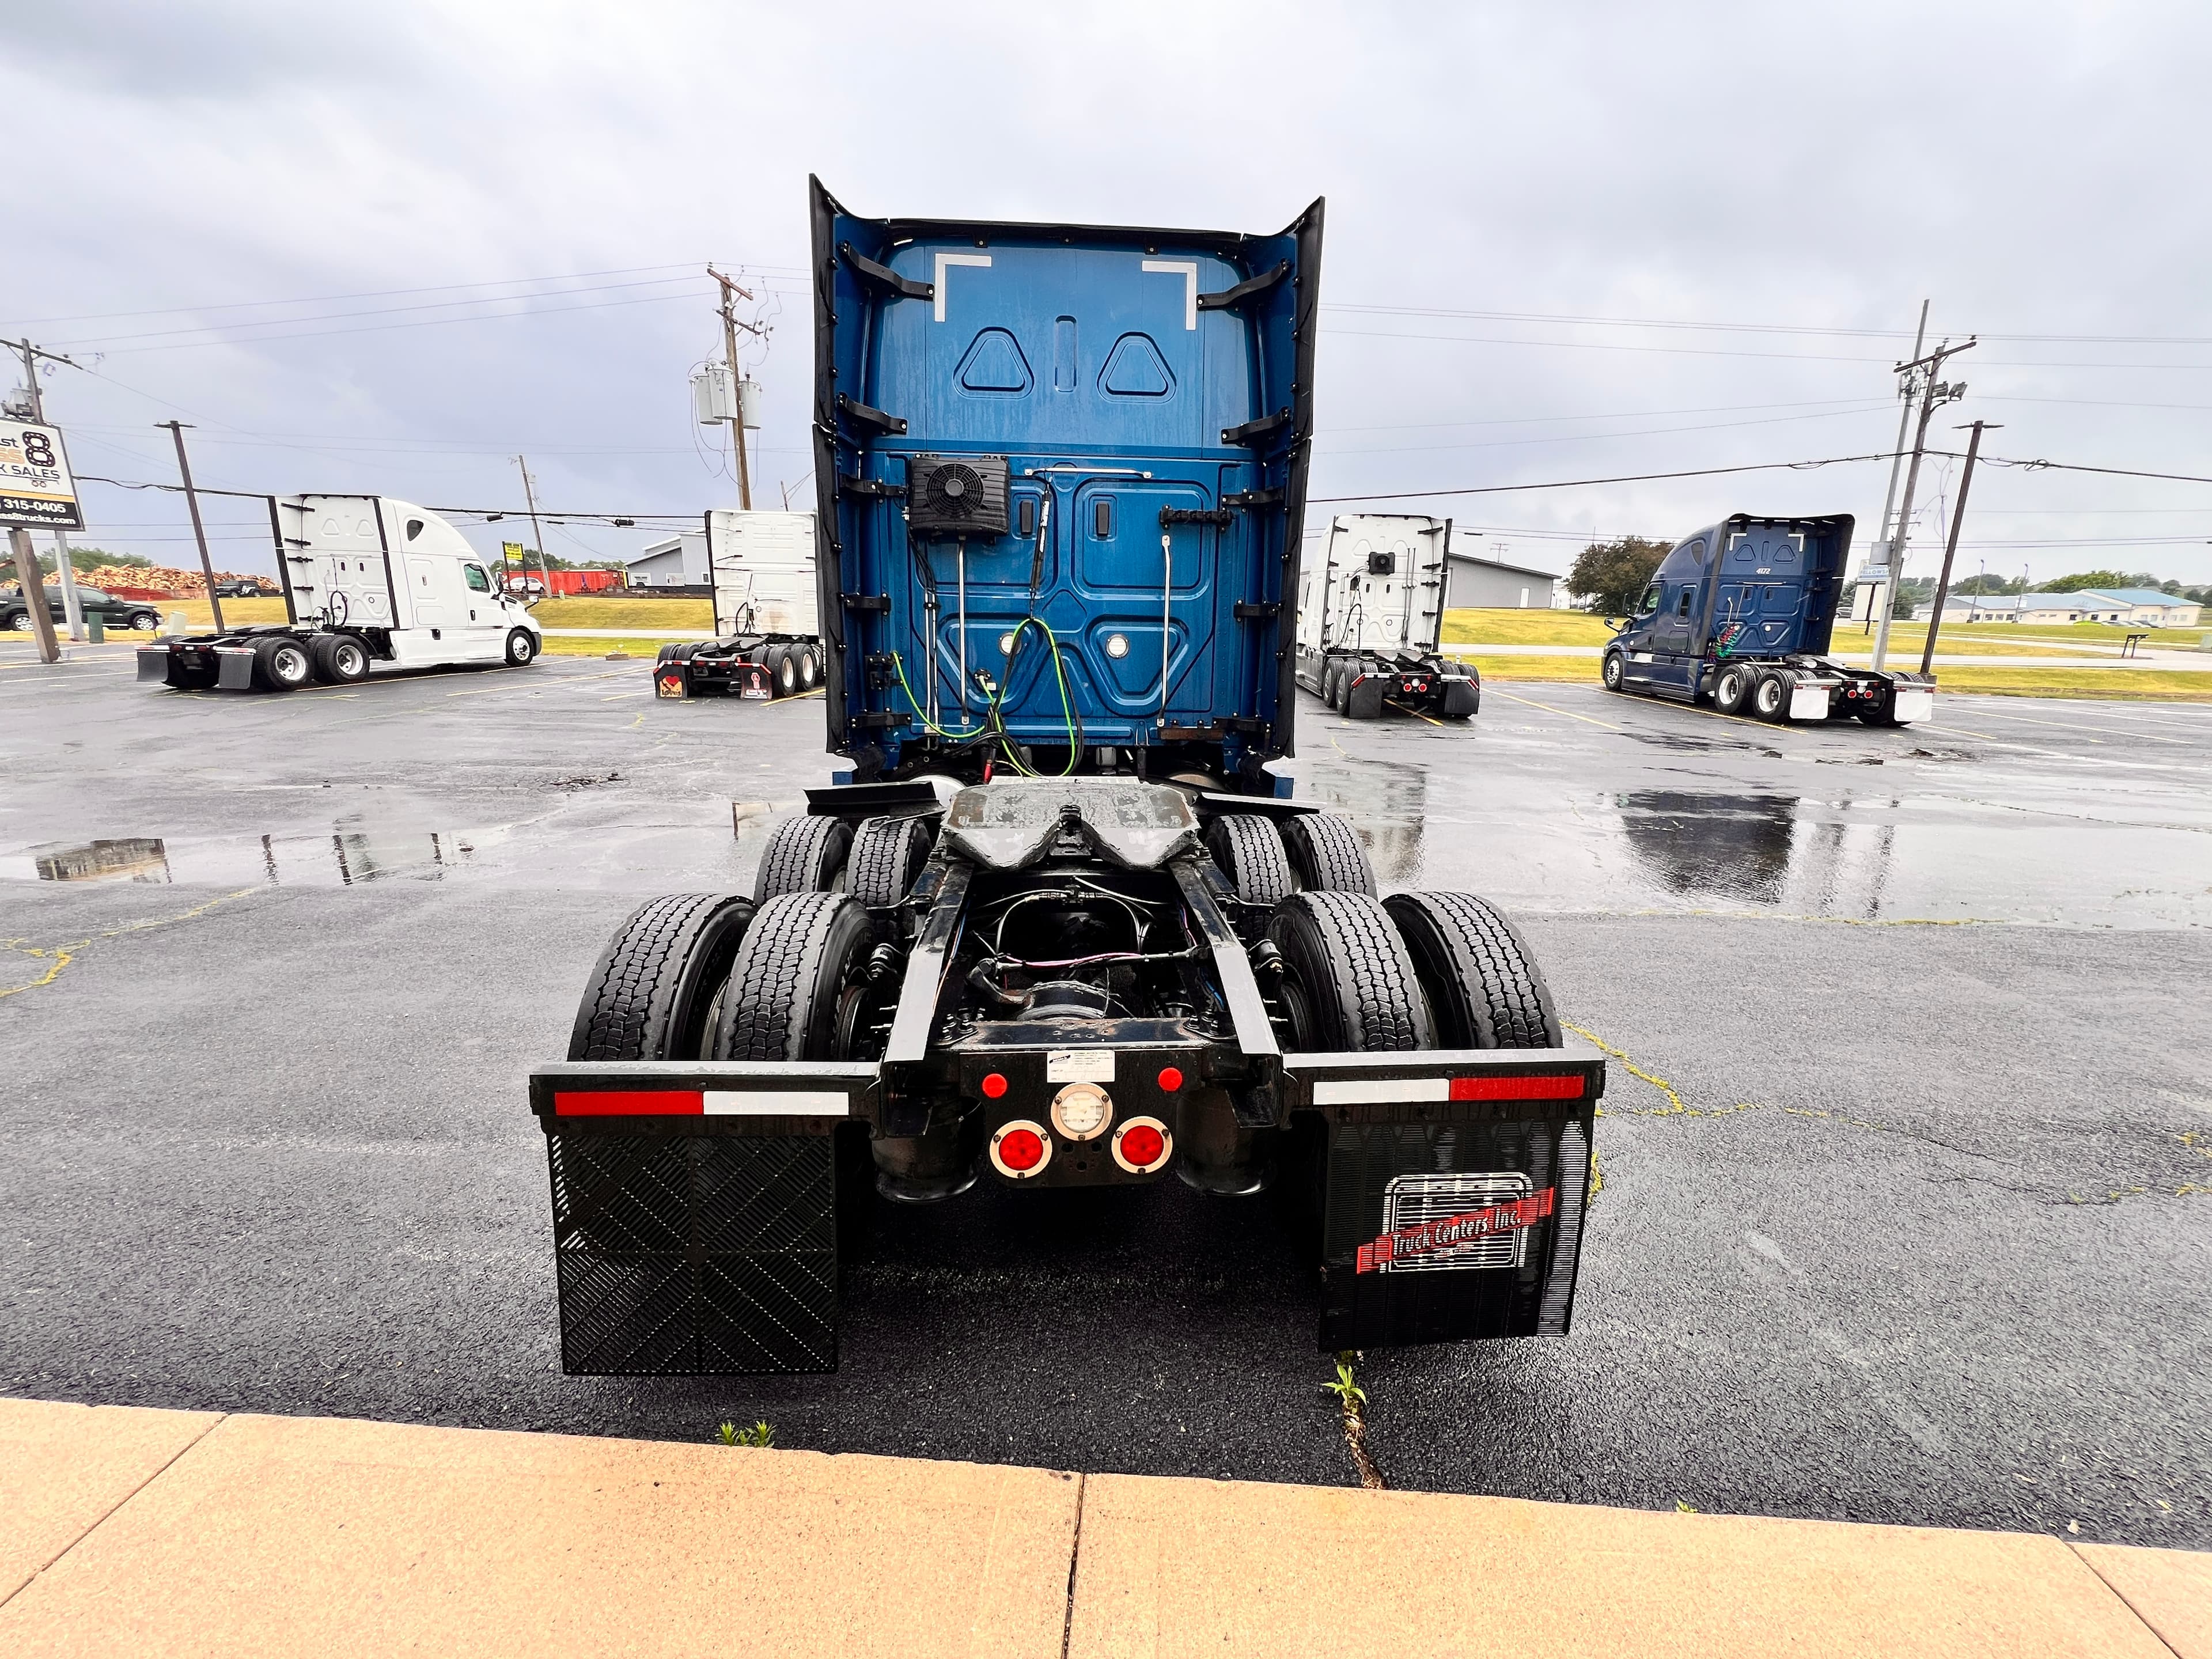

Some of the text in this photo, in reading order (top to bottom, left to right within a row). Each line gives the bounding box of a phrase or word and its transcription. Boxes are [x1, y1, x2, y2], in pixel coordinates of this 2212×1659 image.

[0, 438, 20, 448] st
[12, 465, 60, 479] SALES
[3, 498, 66, 513] 315-0405
[0, 512, 75, 525] ss8trucks.com
[1392, 1226, 1431, 1255] Truck
